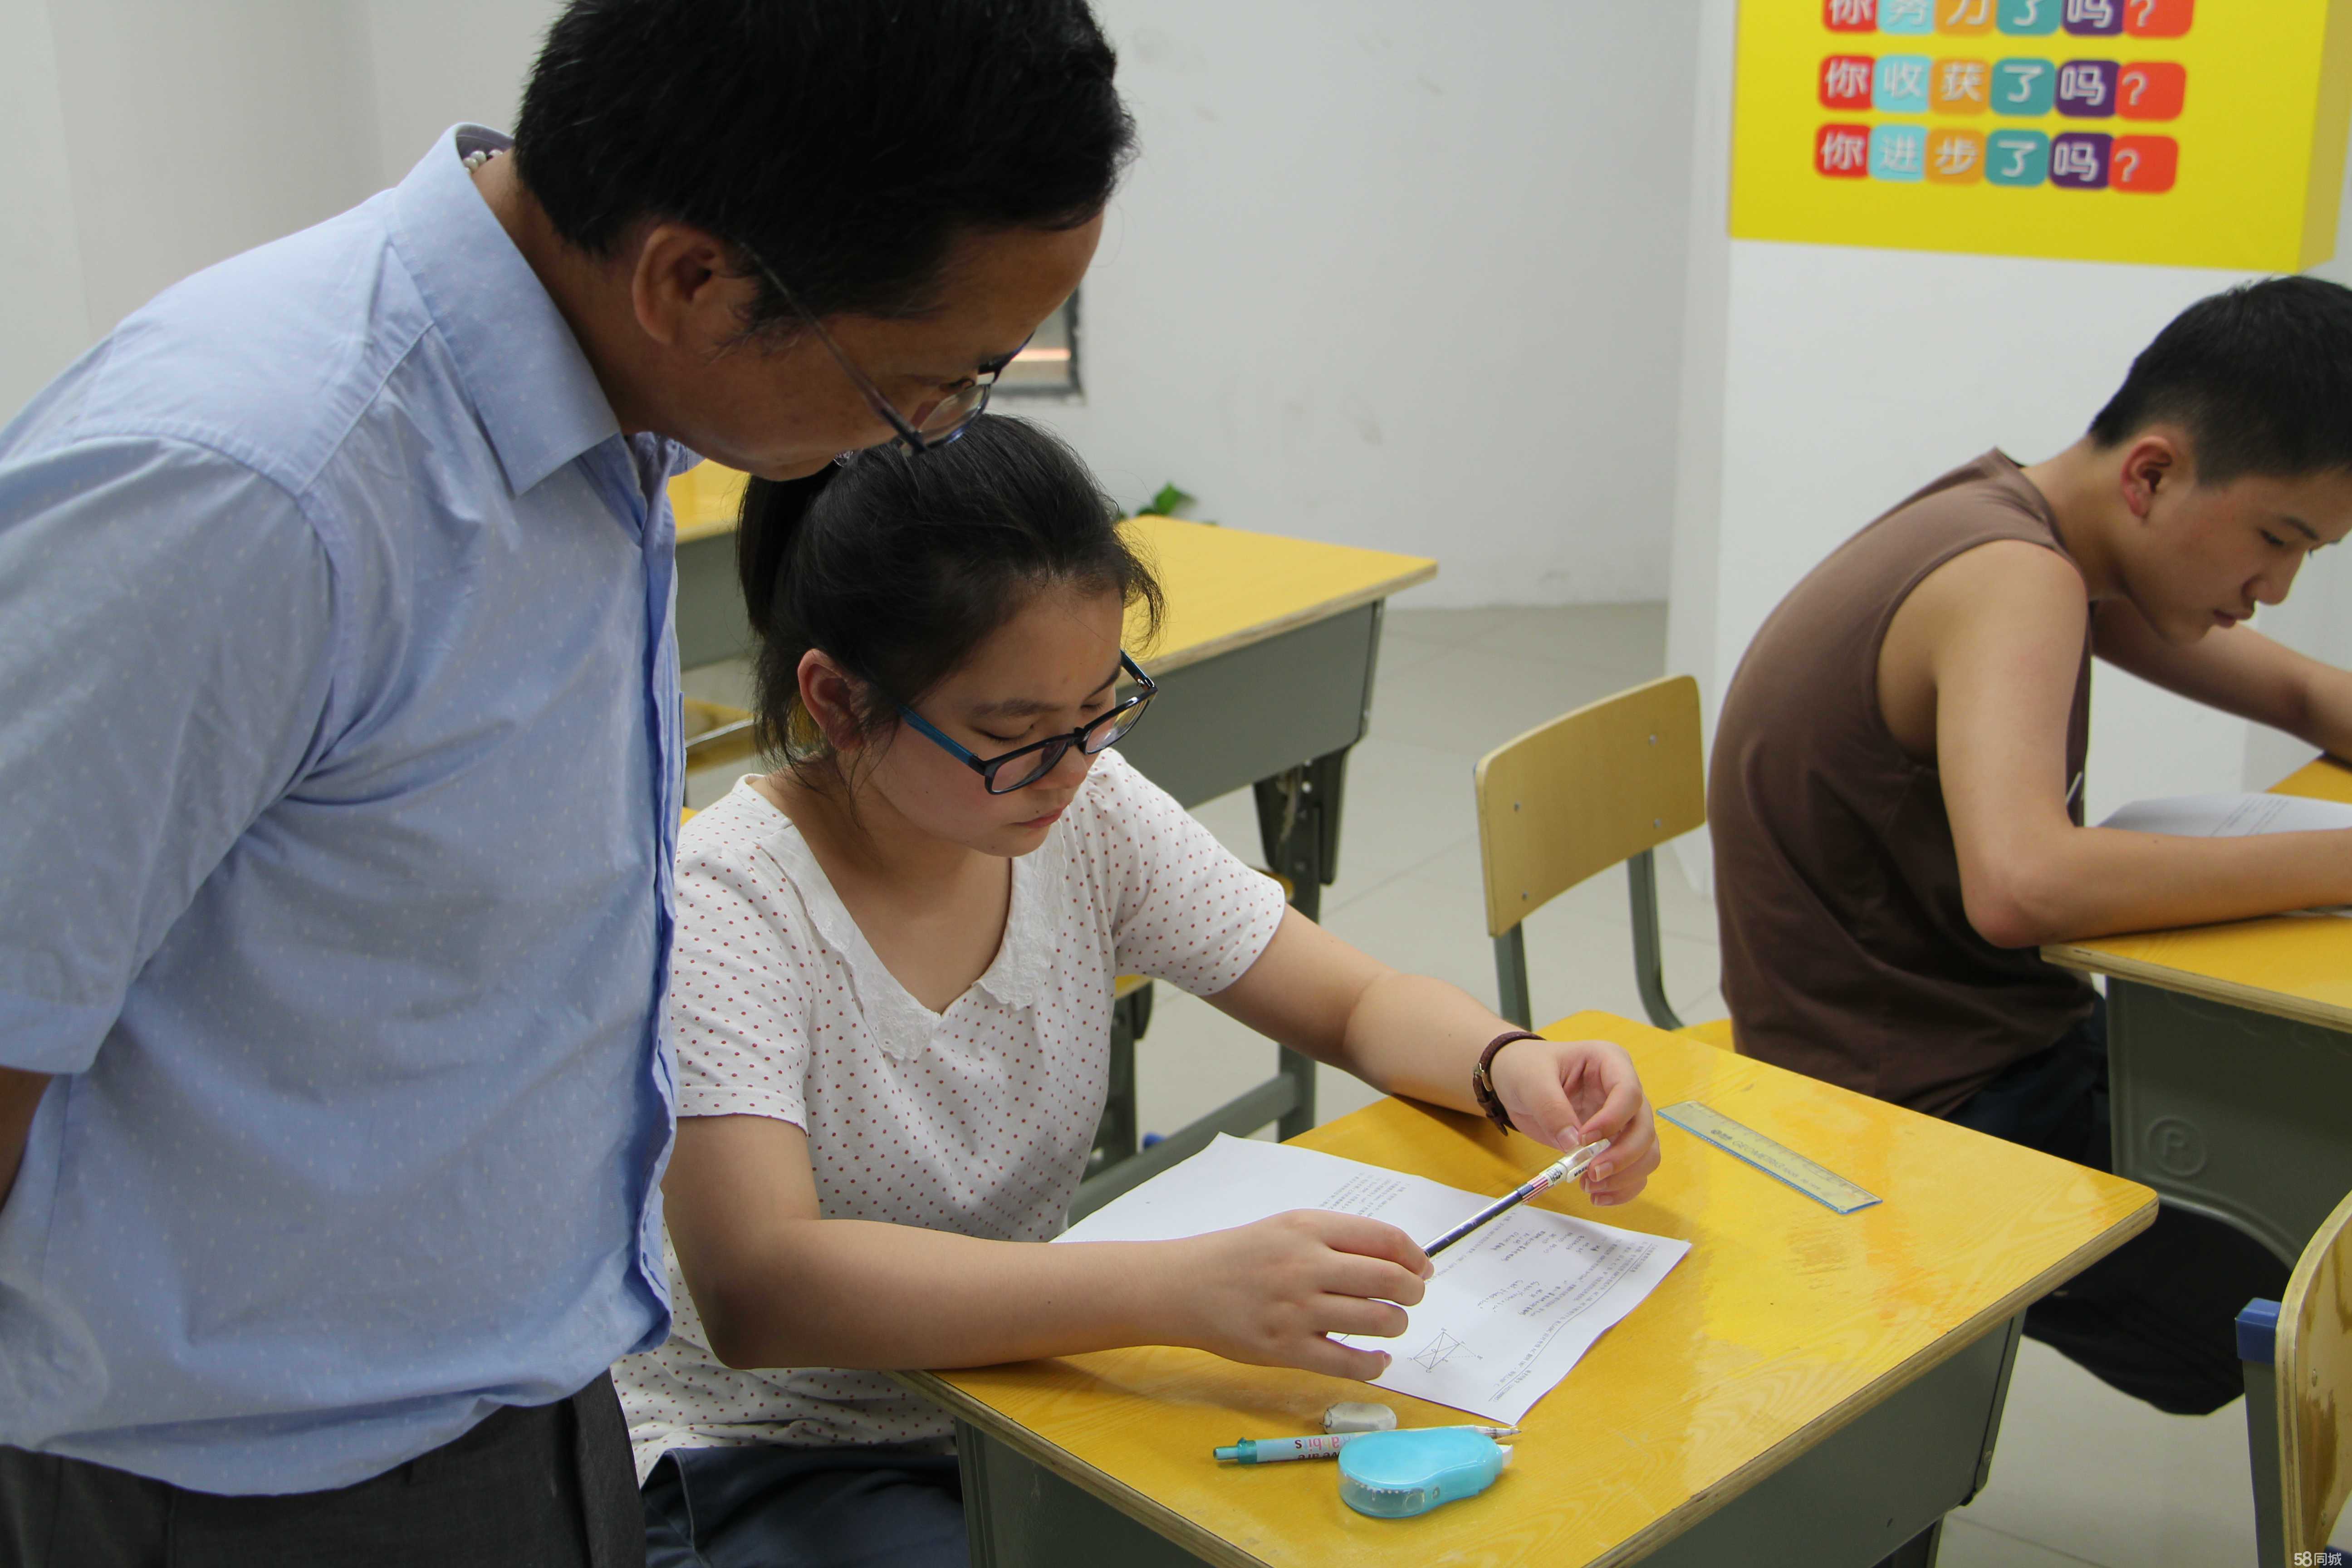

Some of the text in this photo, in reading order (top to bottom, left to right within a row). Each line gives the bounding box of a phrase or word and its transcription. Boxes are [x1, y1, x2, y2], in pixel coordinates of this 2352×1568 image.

[1824, 61, 2147, 106] 你收获了吗？
[1821, 132, 2140, 182] 你进步了吗？
